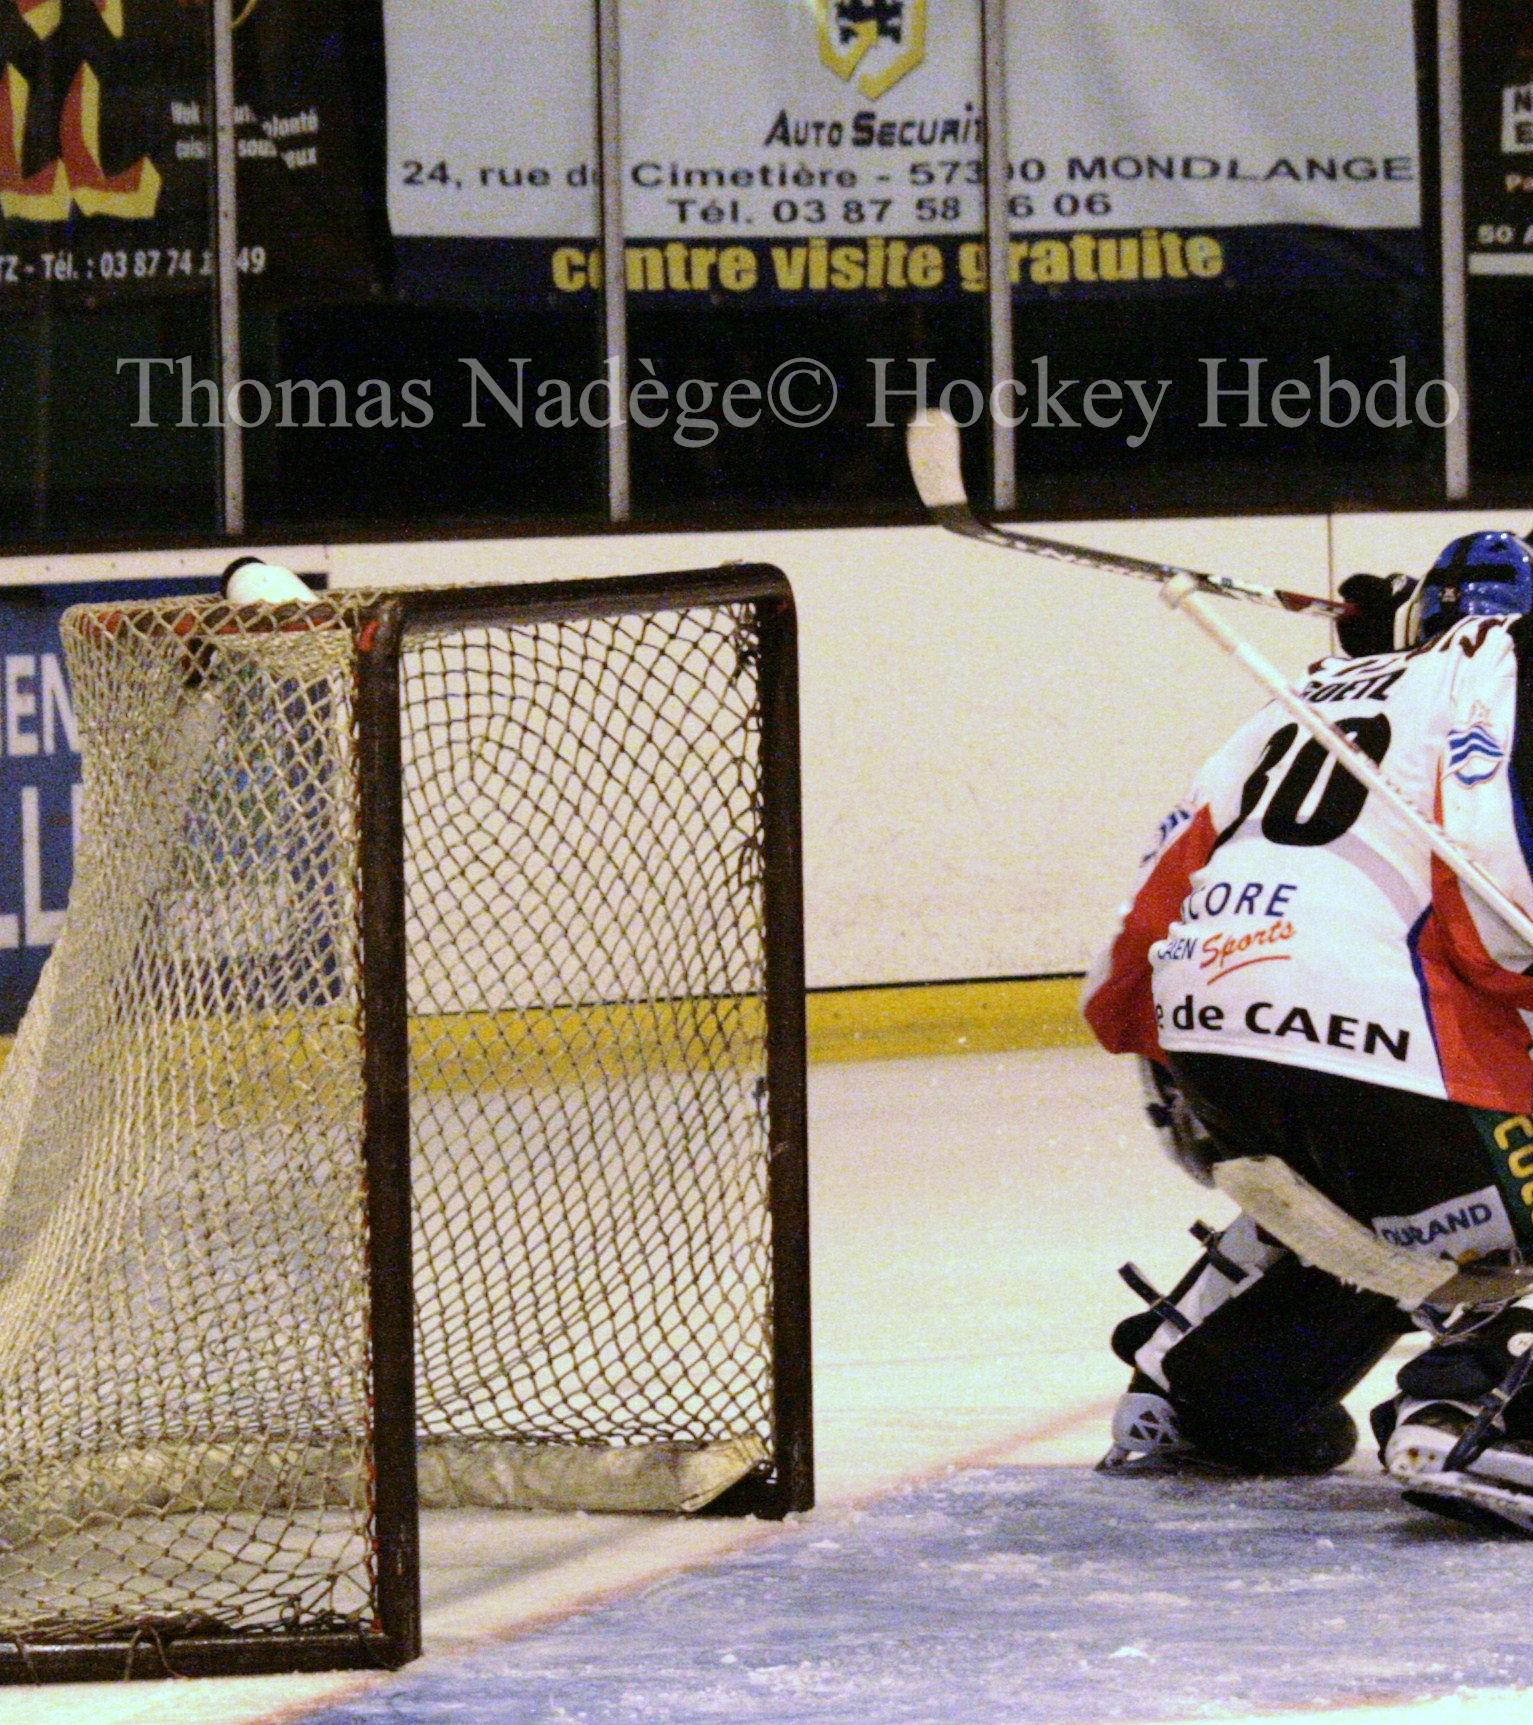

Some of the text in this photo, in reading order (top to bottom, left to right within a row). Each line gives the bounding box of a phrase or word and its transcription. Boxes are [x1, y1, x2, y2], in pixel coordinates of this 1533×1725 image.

[402, 161, 463, 191] 24,
[478, 166, 551, 188] rue
[631, 160, 858, 188] Cimetière
[909, 157, 1046, 187] 5730
[1067, 155, 1414, 183] MONDLANGE
[667, 197, 754, 225] Tél.
[772, 200, 828, 225] 03
[842, 199, 893, 224] 87
[915, 196, 962, 222] 58
[1053, 191, 1112, 218] 06
[100, 249, 128, 280] 03
[134, 248, 161, 278] 87
[167, 247, 192, 277] 74
[237, 246, 267, 275] 49
[771, 237, 944, 292] visite
[959, 228, 1225, 293] gratuite
[1199, 920, 1297, 969] Sports
[1172, 993, 1225, 1031] de
[1244, 1000, 1412, 1063] CAEN
[1379, 1203, 1494, 1247] DURAND
